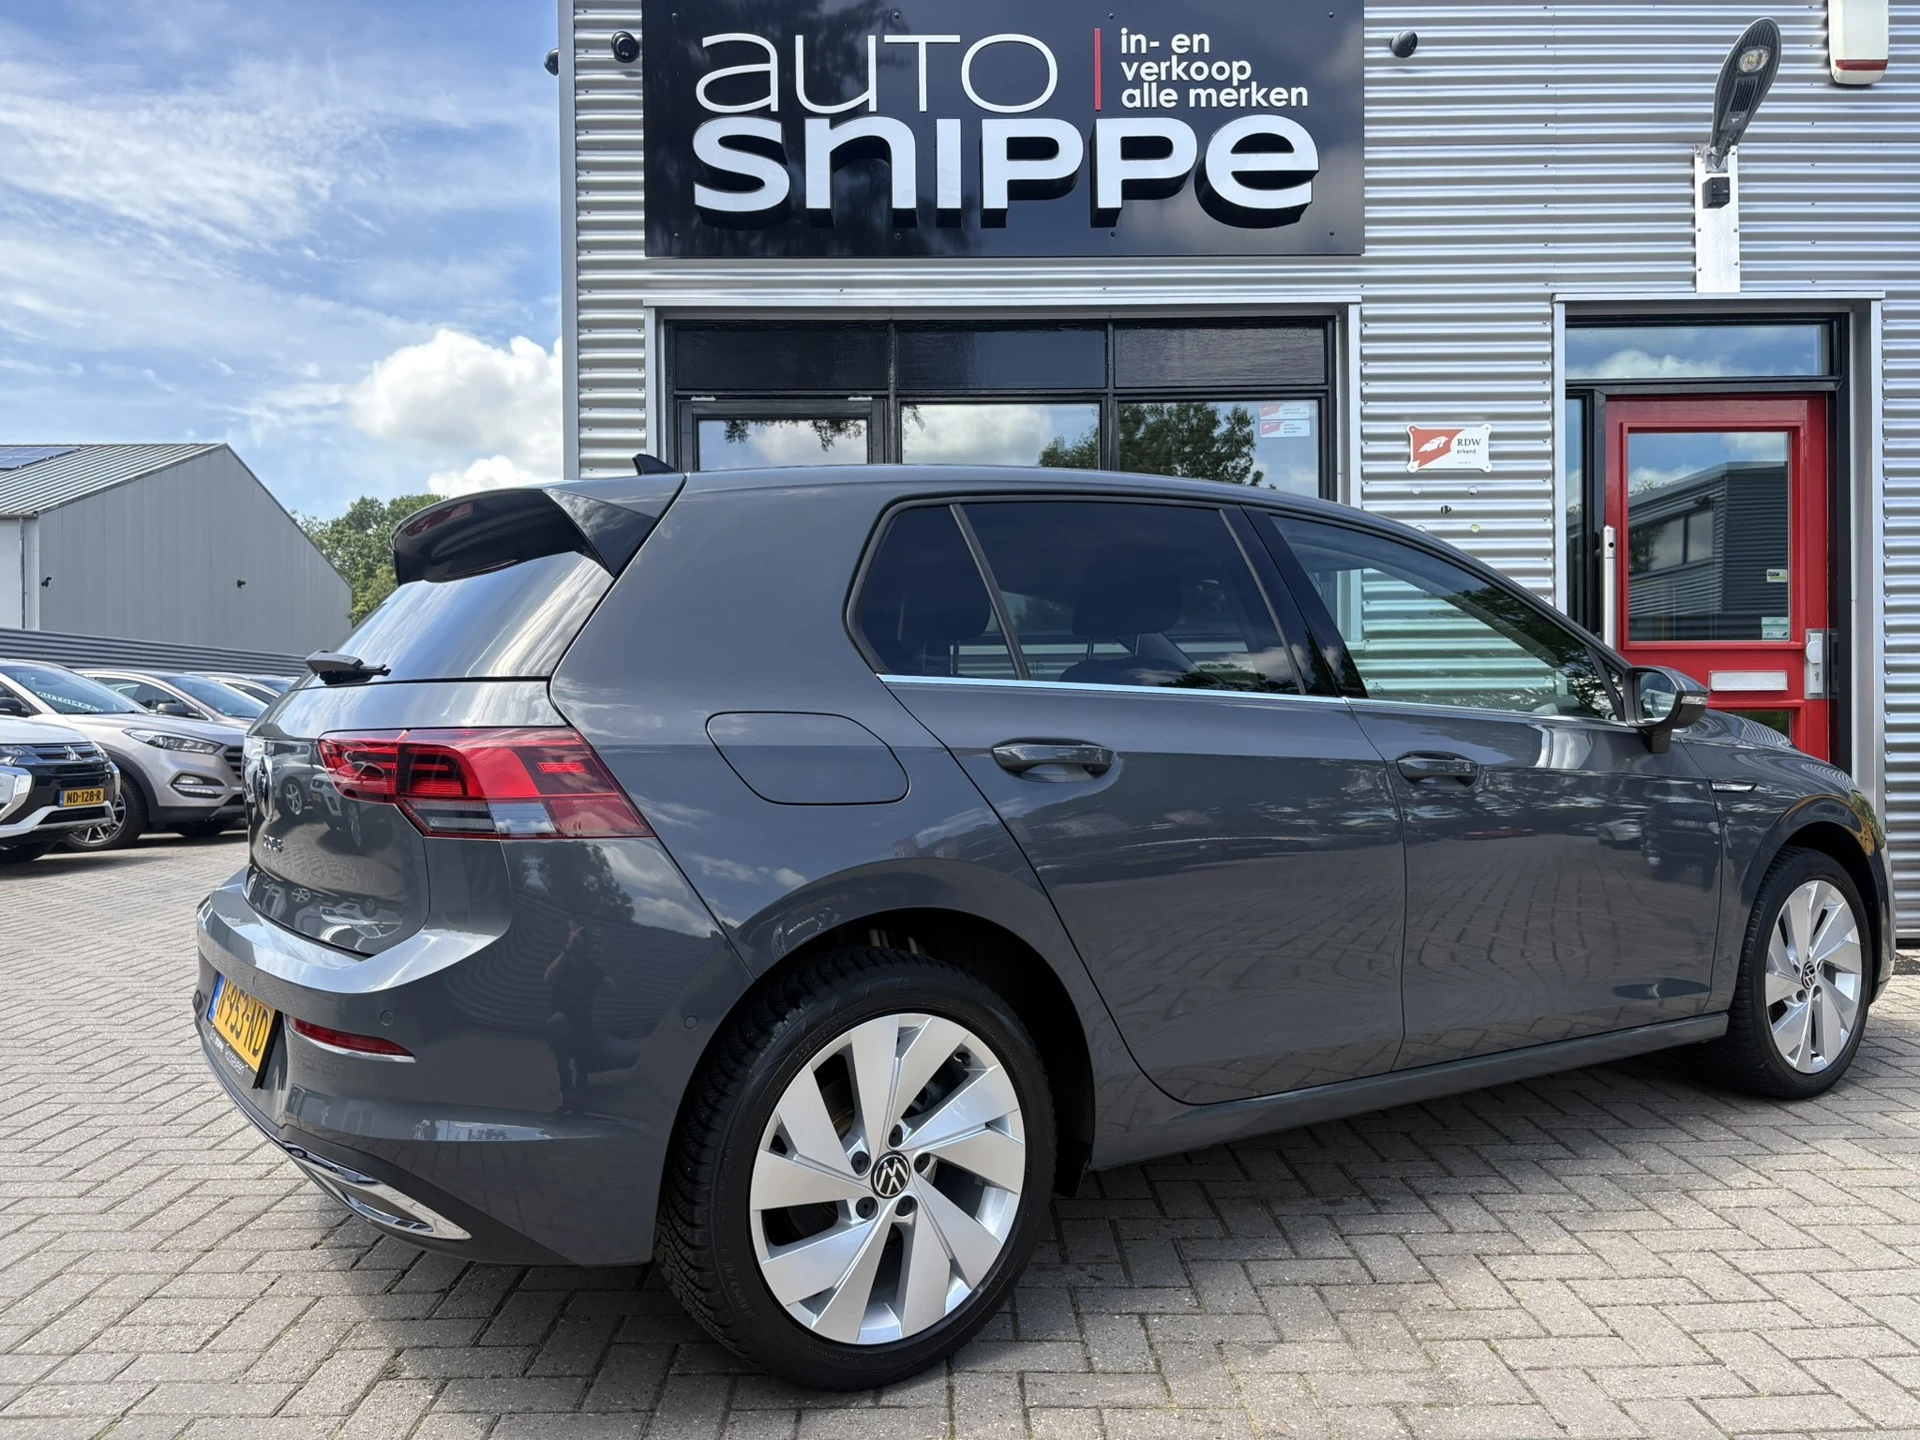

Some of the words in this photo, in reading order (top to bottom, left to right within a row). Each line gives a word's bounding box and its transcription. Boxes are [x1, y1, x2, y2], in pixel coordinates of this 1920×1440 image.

[1120, 27, 1160, 54] in-
[1171, 32, 1210, 54] en
[1120, 55, 1252, 87] verkoop
[1121, 82, 1179, 109] alle
[1188, 81, 1309, 108] merken
[1457, 438, 1482, 447] RDW
[66, 790, 102, 804] ND-128-R
